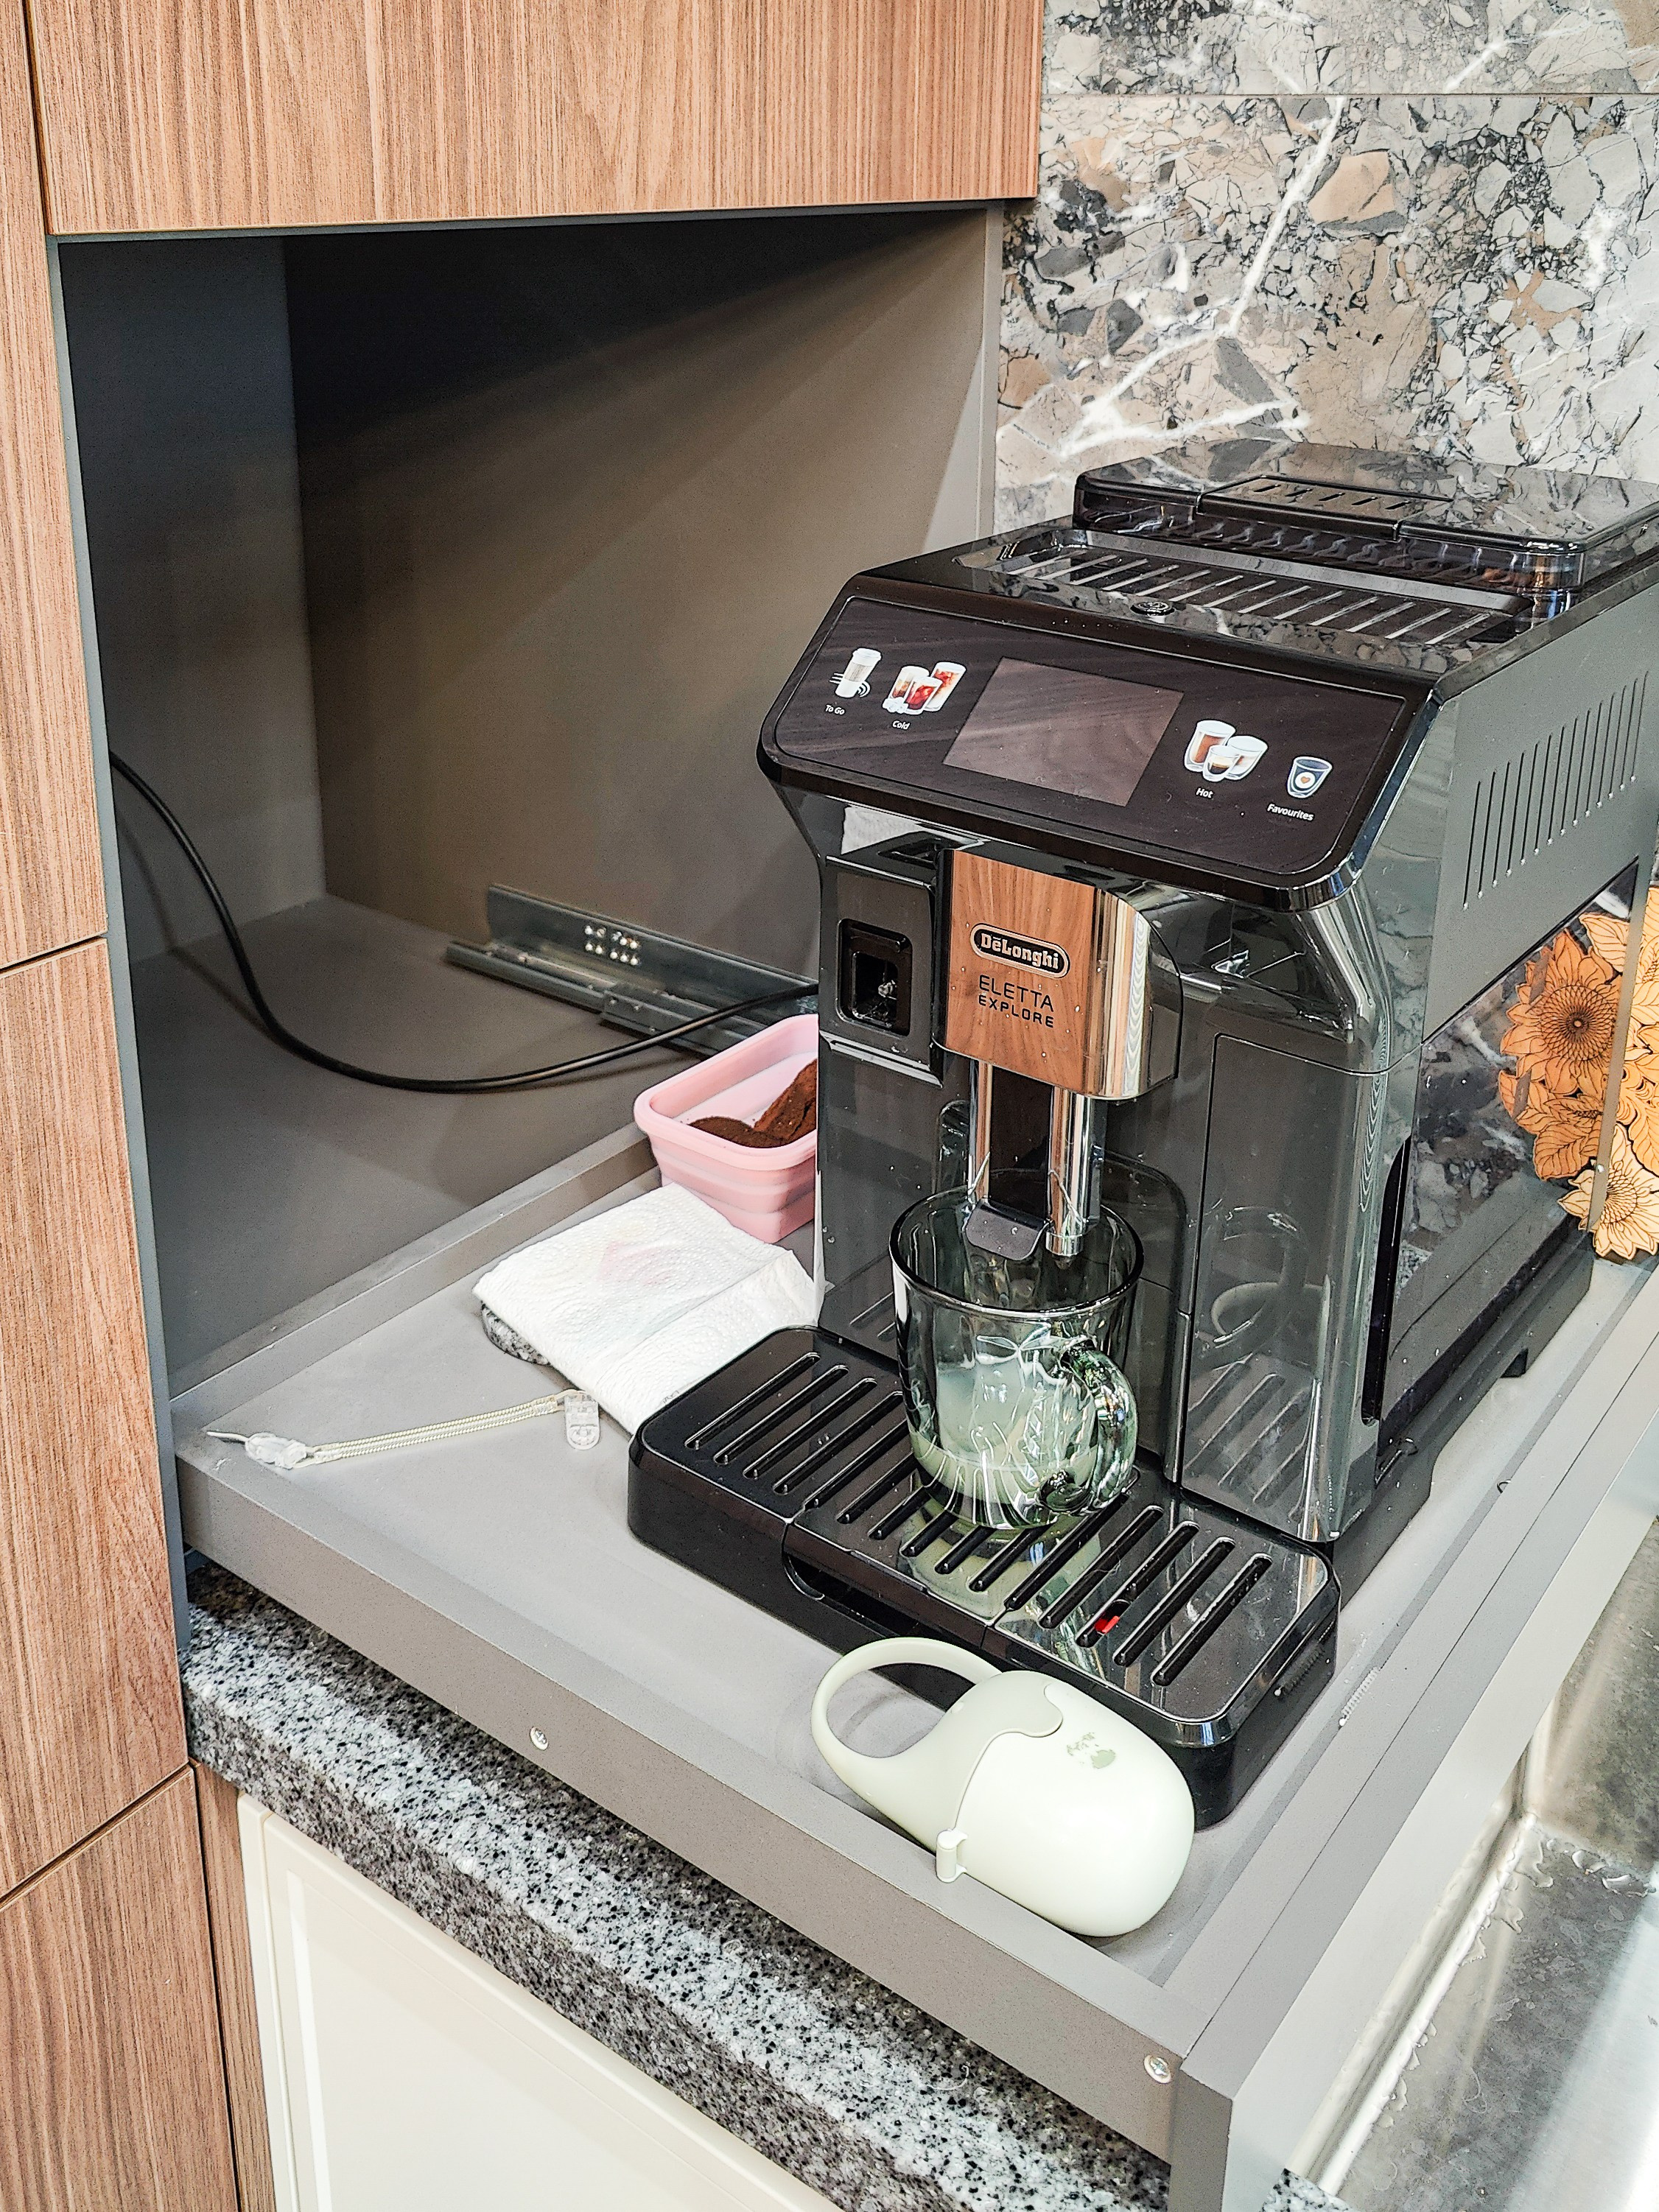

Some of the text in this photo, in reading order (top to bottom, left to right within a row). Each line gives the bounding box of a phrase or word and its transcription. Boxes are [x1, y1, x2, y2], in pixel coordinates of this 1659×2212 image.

[825, 704, 845, 714] To Go
[892, 720, 910, 730] Cold
[1196, 787, 1213, 798] Hot
[1267, 804, 1313, 821] Favourites
[979, 975, 1053, 1012] ELETTA
[978, 994, 1053, 1028] EXPLORE
